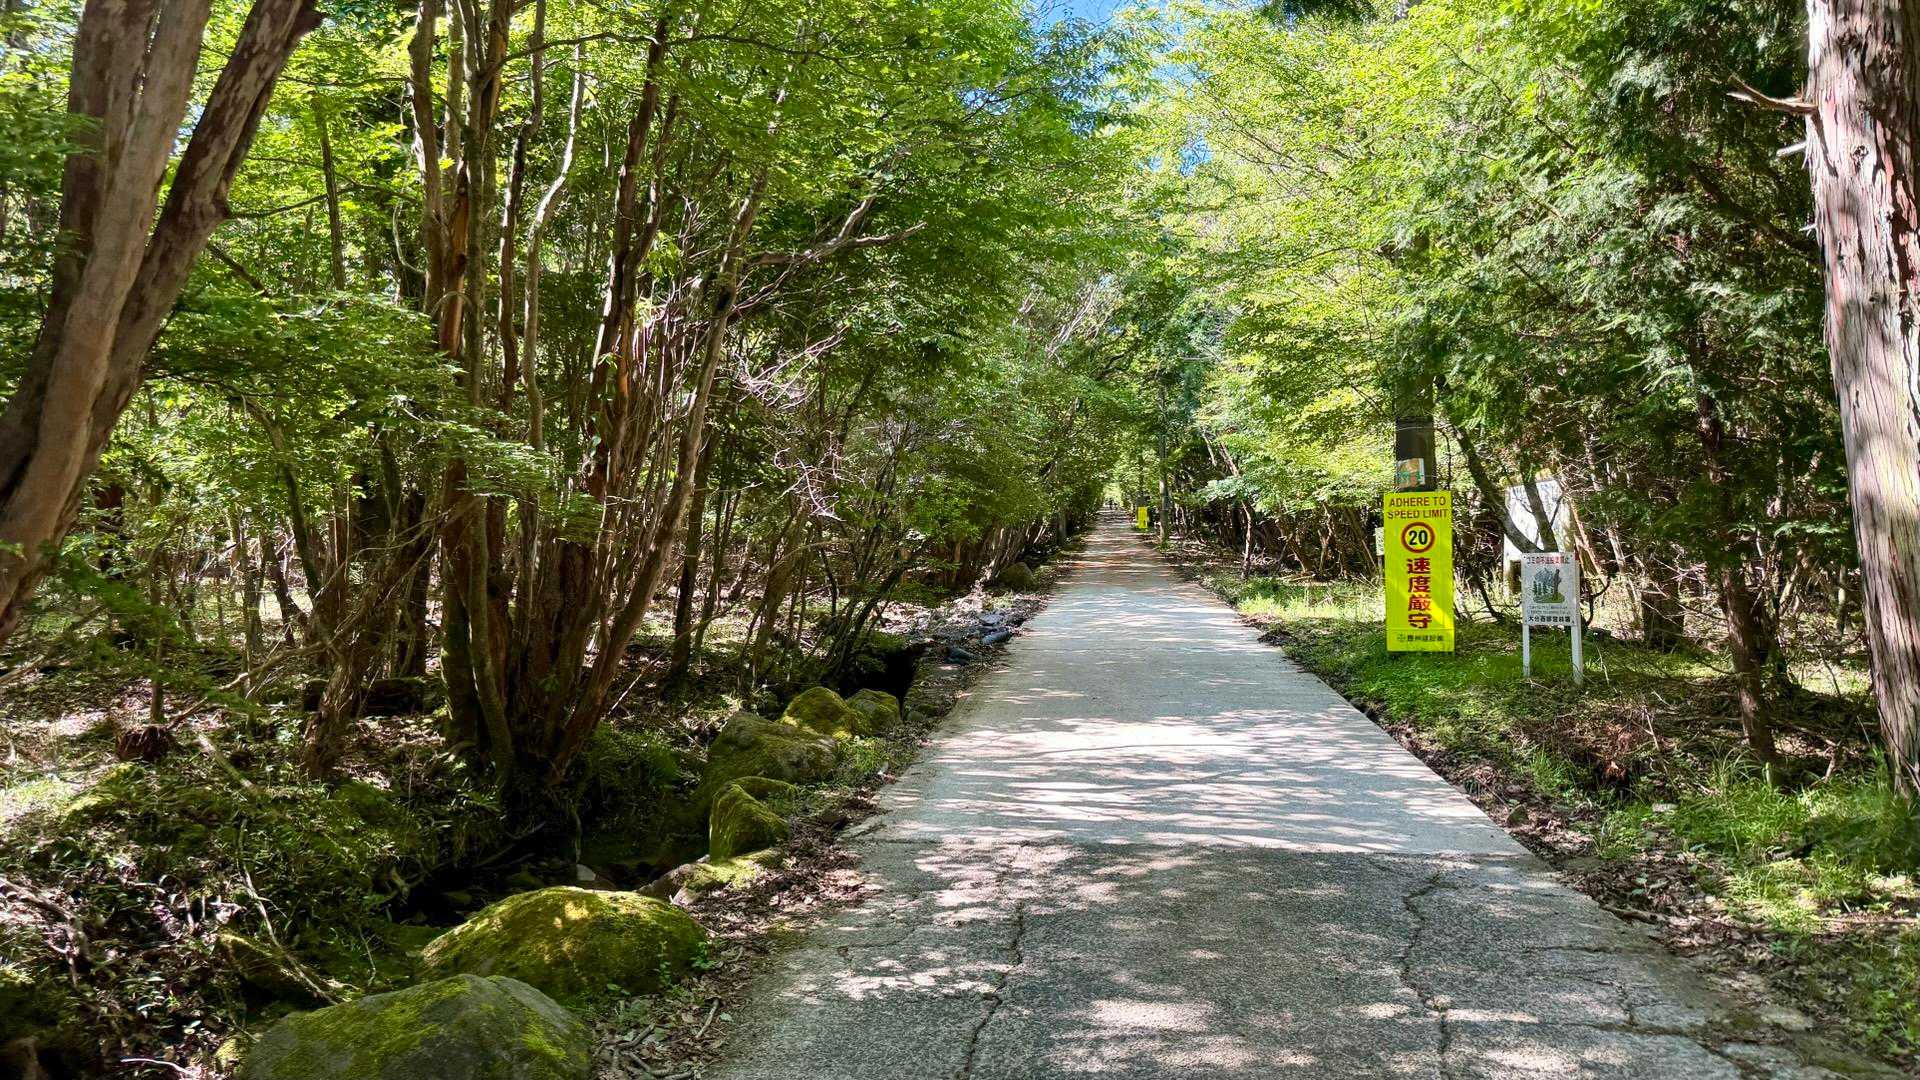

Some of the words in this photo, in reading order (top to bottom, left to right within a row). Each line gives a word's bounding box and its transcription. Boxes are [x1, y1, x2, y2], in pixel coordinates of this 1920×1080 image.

[1389, 497, 1430, 507] ADHERE
[1432, 496, 1446, 506] TO
[1387, 510, 1420, 519] SPEED
[1423, 509, 1448, 518] LIMIT
[1409, 530, 1428, 545] 20
[1407, 557, 1432, 628] 速度厳守
